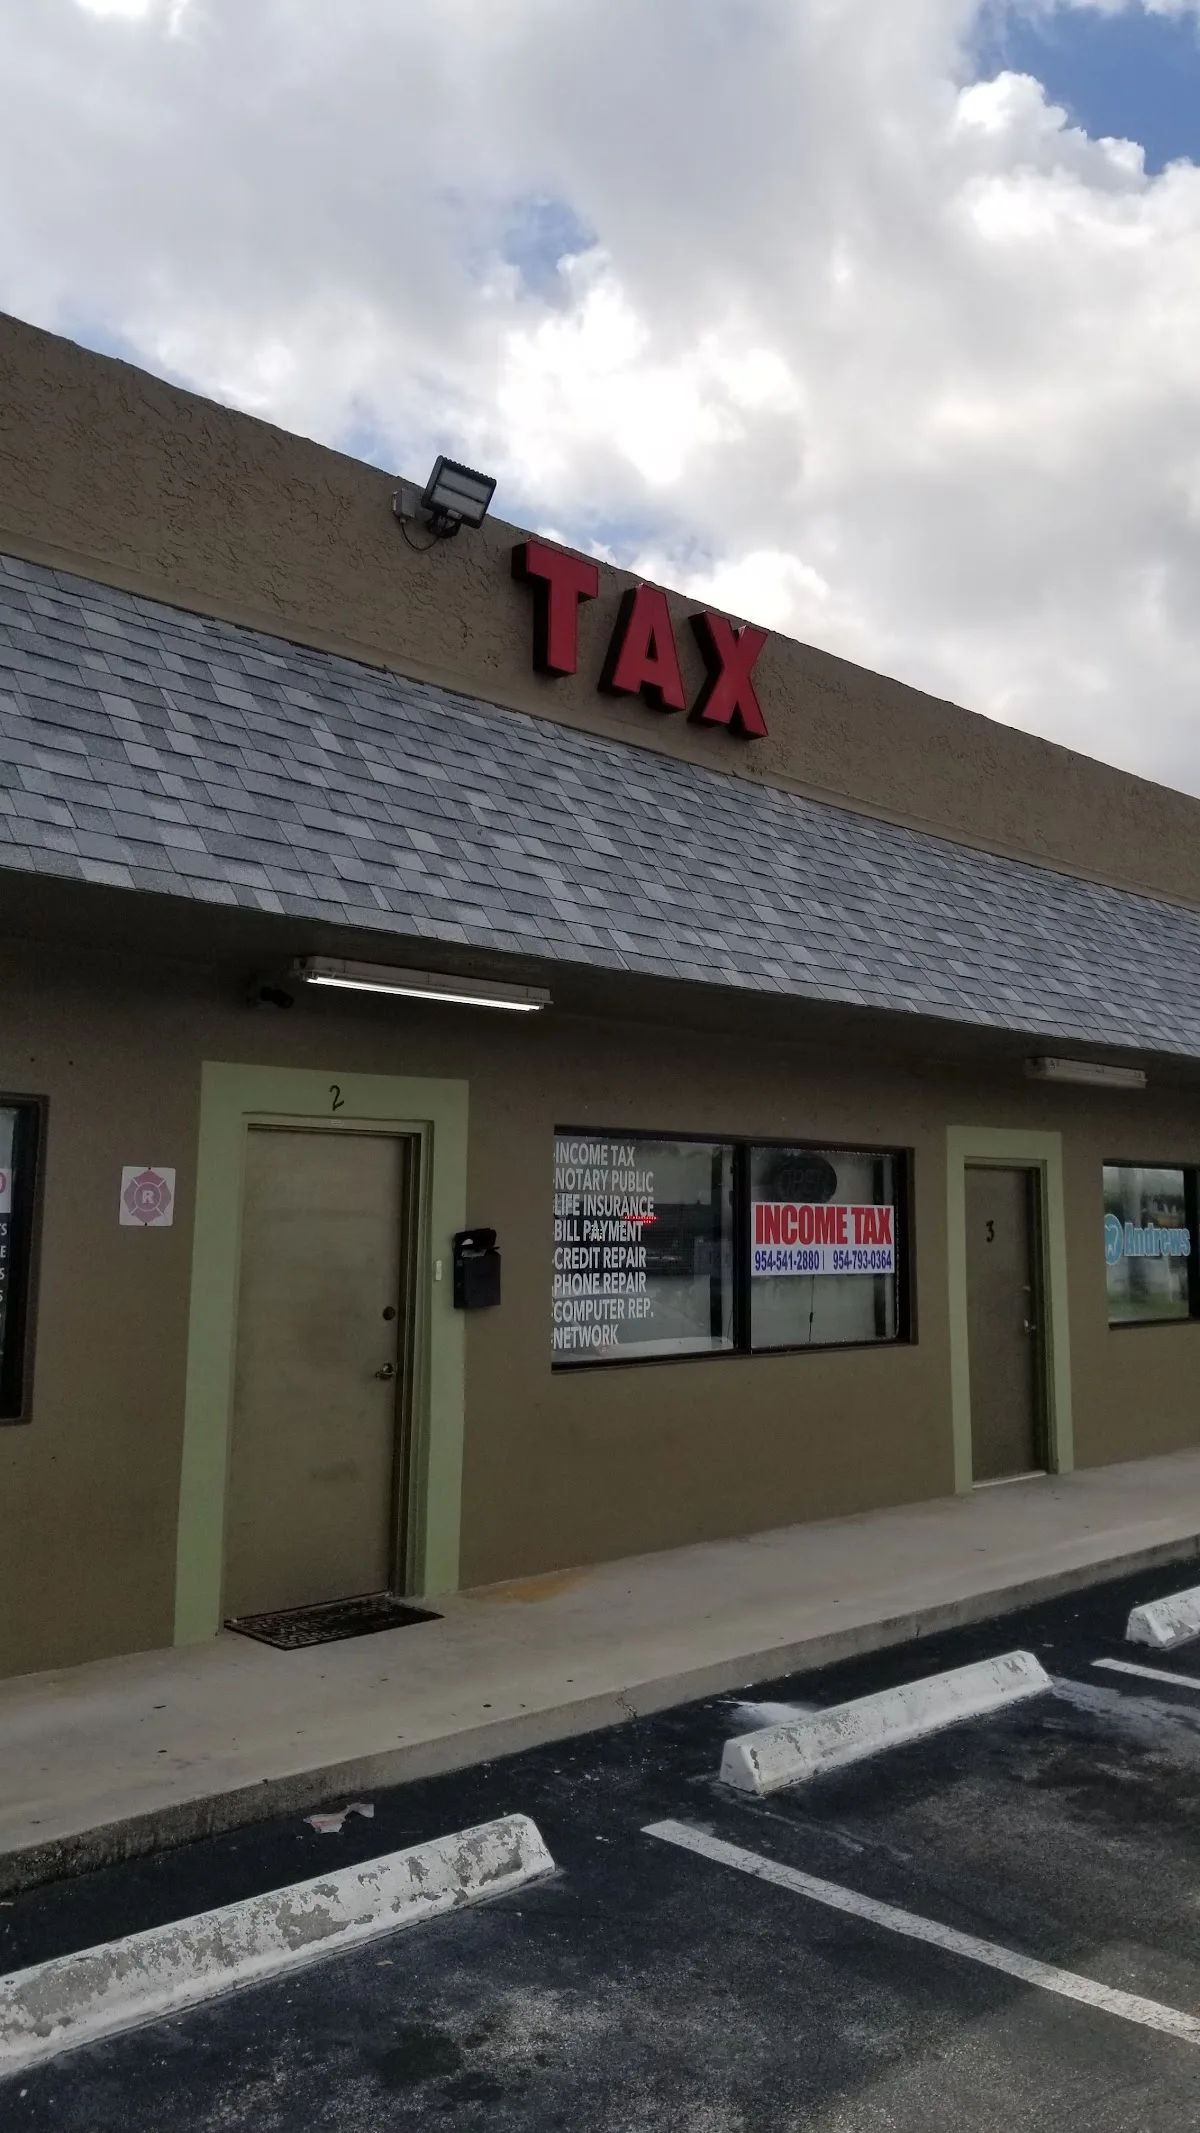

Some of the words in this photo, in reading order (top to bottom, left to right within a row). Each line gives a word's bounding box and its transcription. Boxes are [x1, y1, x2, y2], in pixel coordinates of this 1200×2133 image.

[512, 538, 769, 740] TAX
[329, 1084, 345, 1111] 2
[555, 1142, 608, 1166] INCOME
[610, 1145, 636, 1167] TAX
[555, 1167, 609, 1191] NOTARY
[611, 1170, 654, 1193] PUBLIC
[141, 1189, 155, 1204] R
[554, 1193, 580, 1216] LIFE
[583, 1194, 655, 1217] INSURANCE
[554, 1219, 580, 1242] BILL
[583, 1220, 644, 1242] PAYMENT
[755, 1204, 848, 1246] INCOME
[851, 1207, 892, 1245] TAX
[985, 1219, 995, 1243] 3
[1124, 1222, 1191, 1256] Andrews
[554, 1246, 601, 1269] CREDIT
[603, 1246, 647, 1269] REPAIR
[755, 1250, 820, 1271] 954-541-2880
[833, 1250, 892, 1270] 954-793-0364
[554, 1272, 600, 1296] PHONE
[603, 1271, 647, 1294] REPAIR
[553, 1298, 625, 1323] COMPUTER
[628, 1297, 654, 1319] REP.
[553, 1323, 619, 1349] NETWORK
